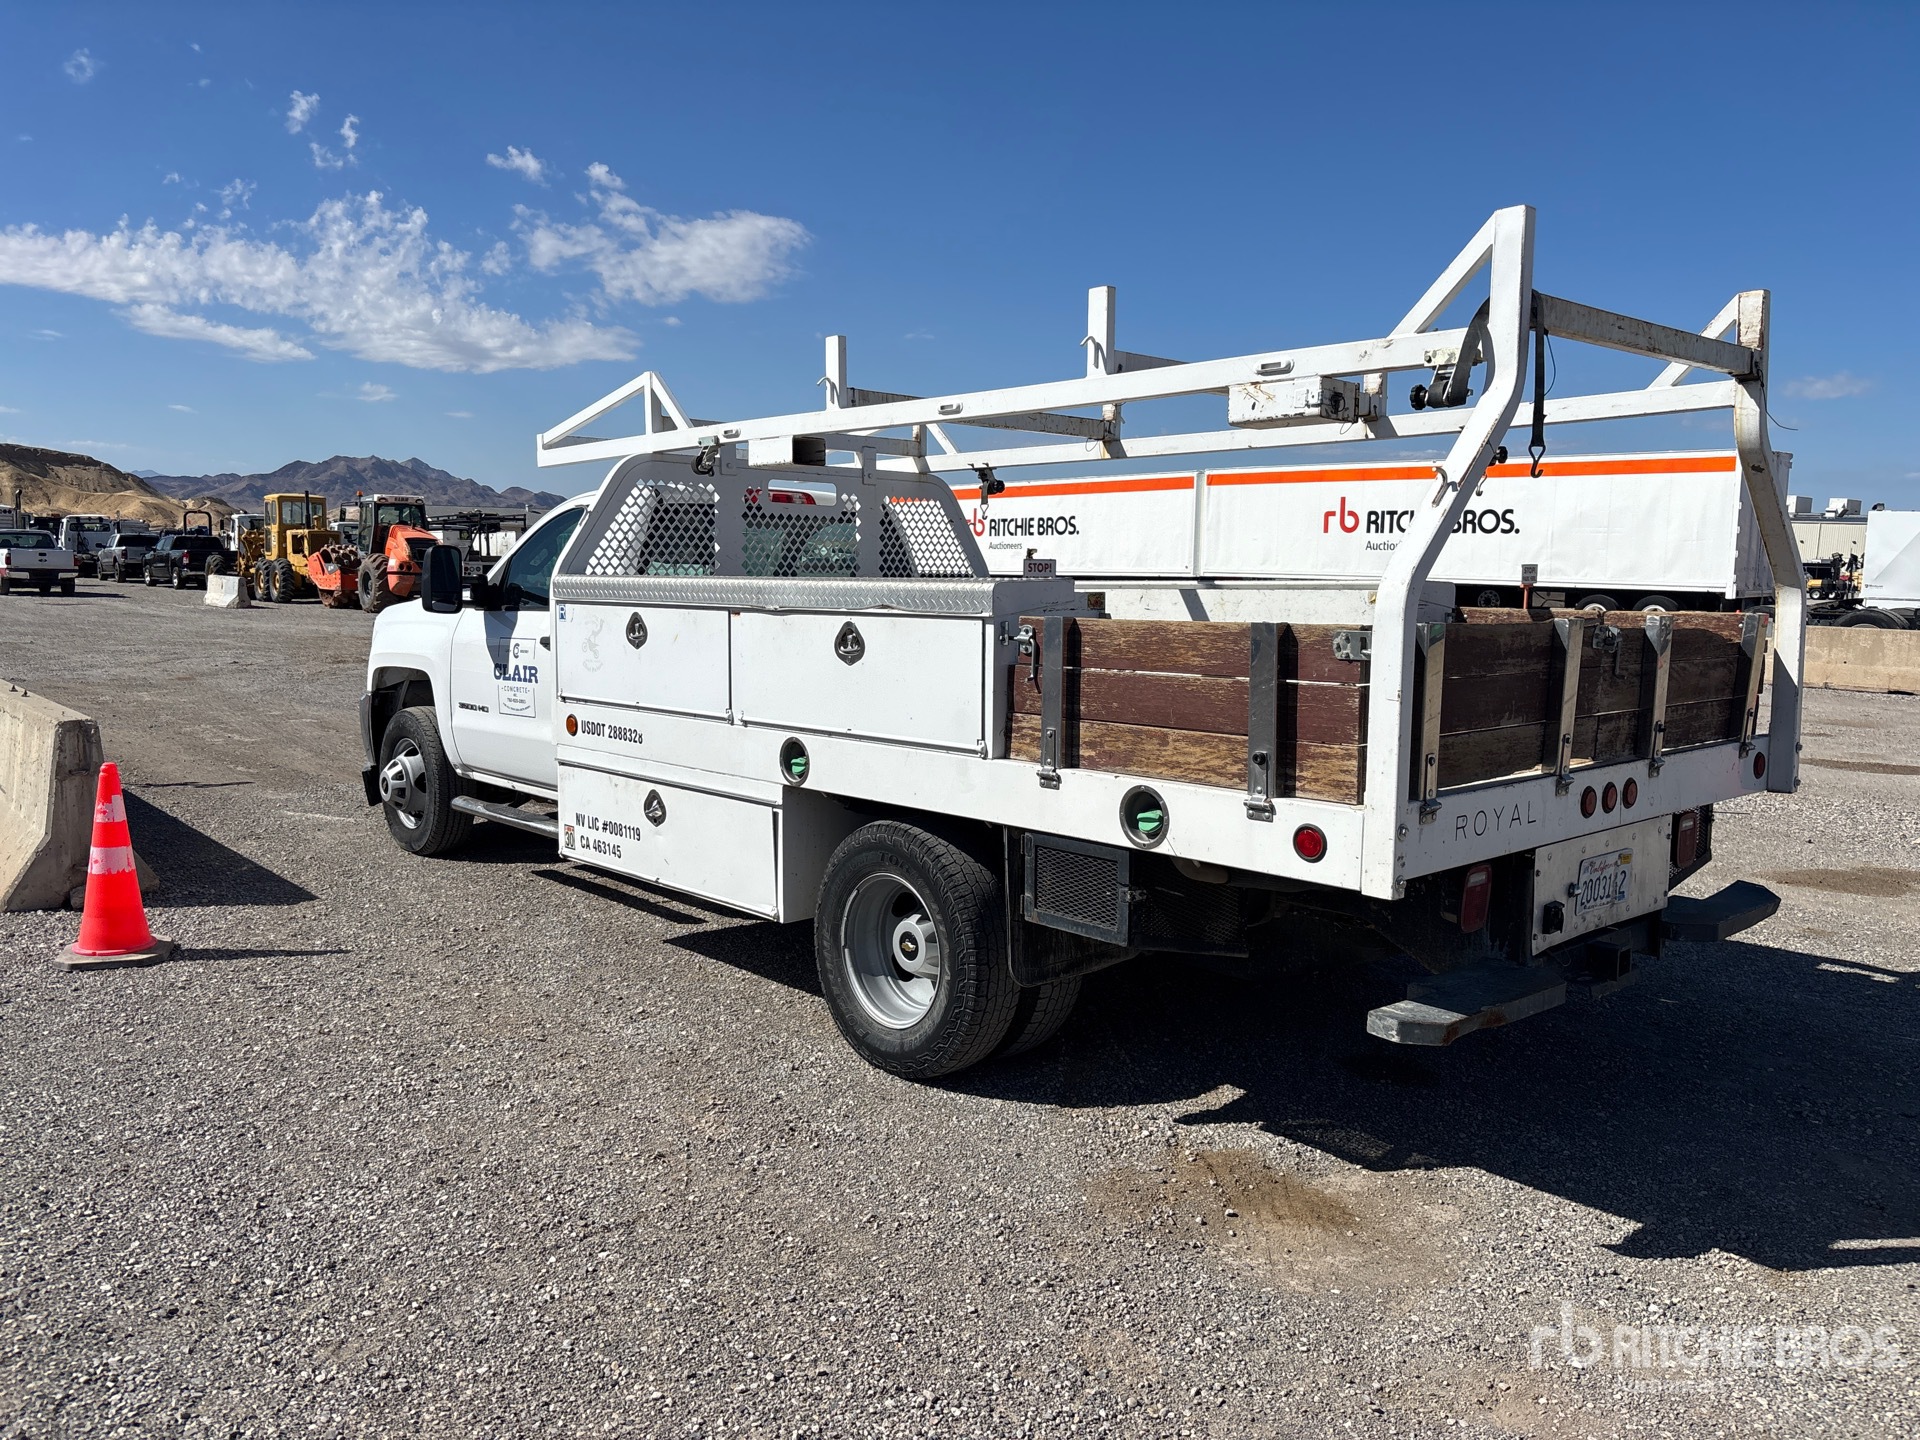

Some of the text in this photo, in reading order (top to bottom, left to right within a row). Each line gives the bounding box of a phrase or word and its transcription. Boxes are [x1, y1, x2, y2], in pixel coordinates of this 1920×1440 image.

[989, 517, 1034, 537] RITCHIE
[1037, 515, 1079, 536] BROS.
[1366, 510, 1414, 534] RITC
[988, 541, 1022, 550] Auctioneers
[1365, 540, 1398, 551] Auctio
[1027, 563, 1052, 573] STOP!
[493, 662, 539, 684] CLAIR
[581, 719, 606, 737] USDOT
[575, 812, 641, 842] NV LIC #0081119
[1454, 800, 1537, 841] ROYAL
[580, 835, 622, 859] CA 463145
